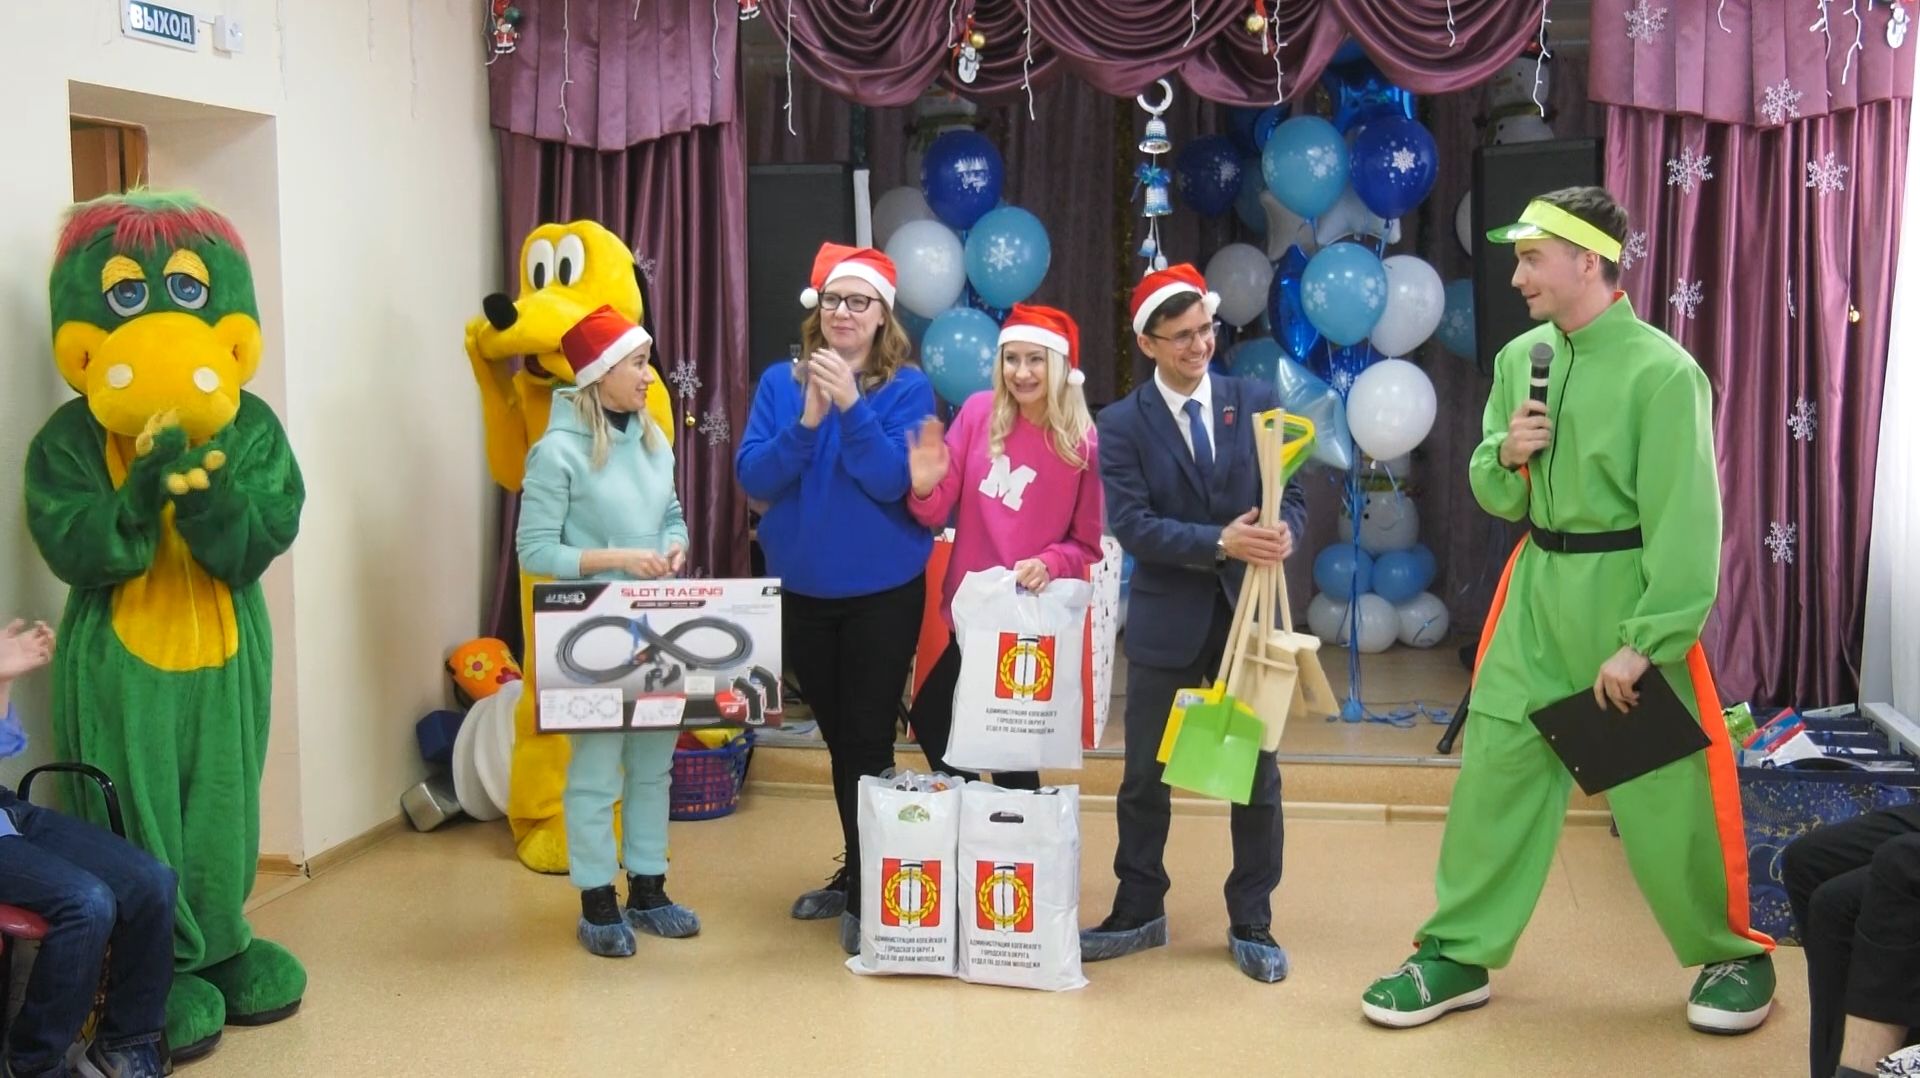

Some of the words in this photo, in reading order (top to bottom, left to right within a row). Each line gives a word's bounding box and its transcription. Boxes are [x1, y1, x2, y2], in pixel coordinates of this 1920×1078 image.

[129, 3, 193, 42] ВЫХОД
[978, 453, 1038, 512] M
[621, 587, 659, 597] SLOT
[665, 586, 723, 597] RACING
